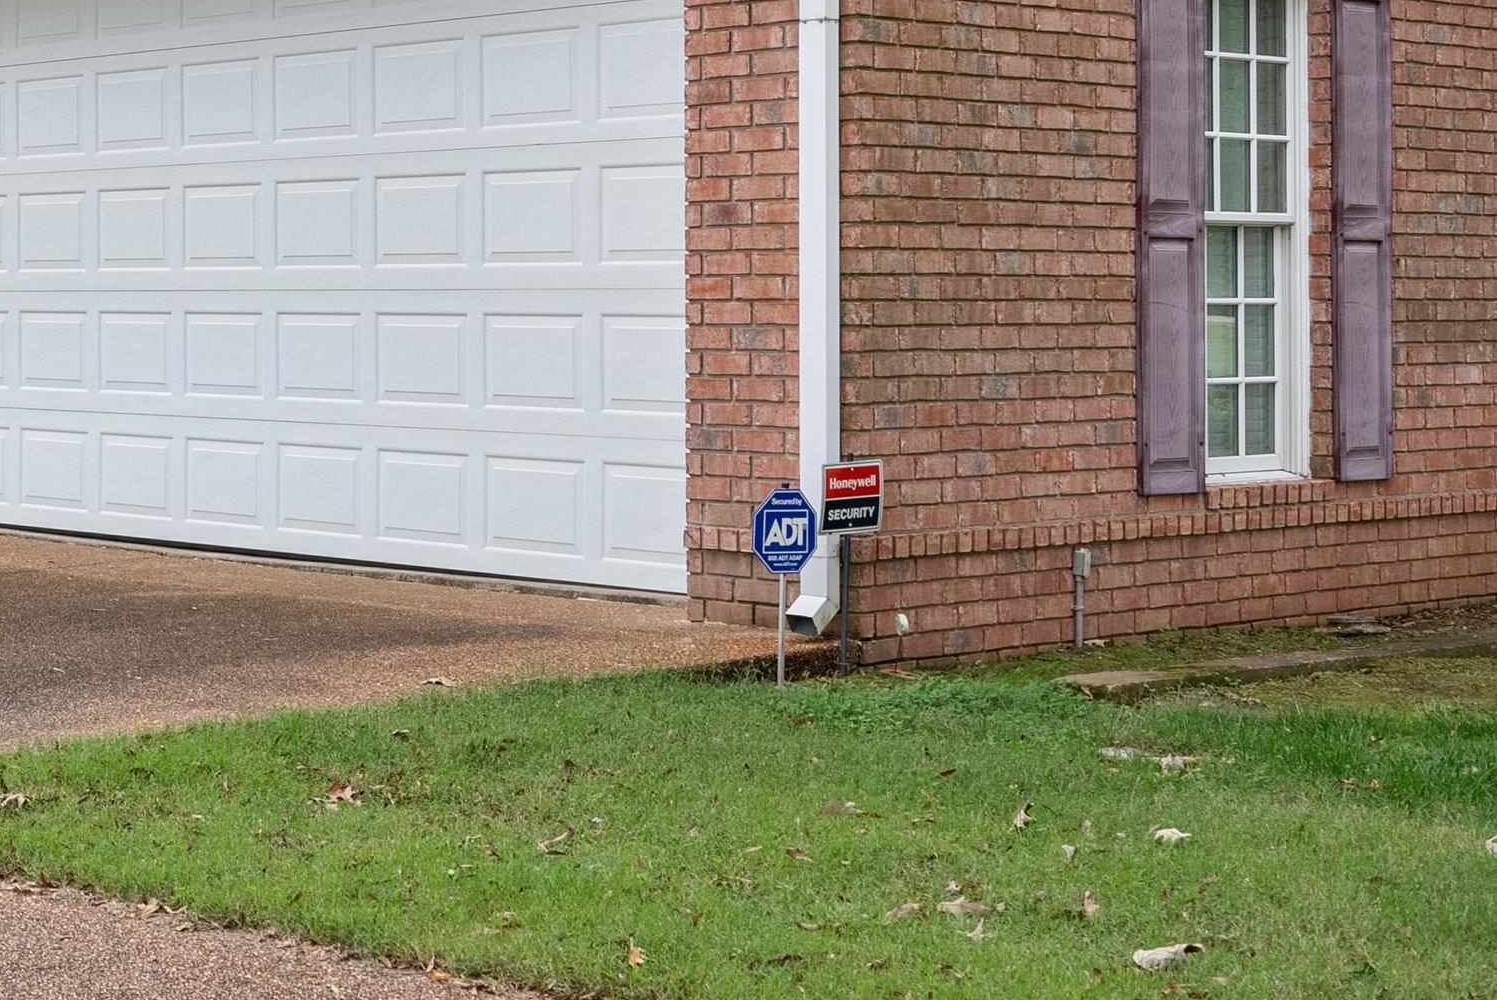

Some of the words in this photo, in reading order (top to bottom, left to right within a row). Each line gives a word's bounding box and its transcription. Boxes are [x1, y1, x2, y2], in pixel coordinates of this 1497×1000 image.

[829, 474, 877, 490] Honeywell
[827, 506, 875, 521] SECURITY
[765, 517, 808, 547] ADT
